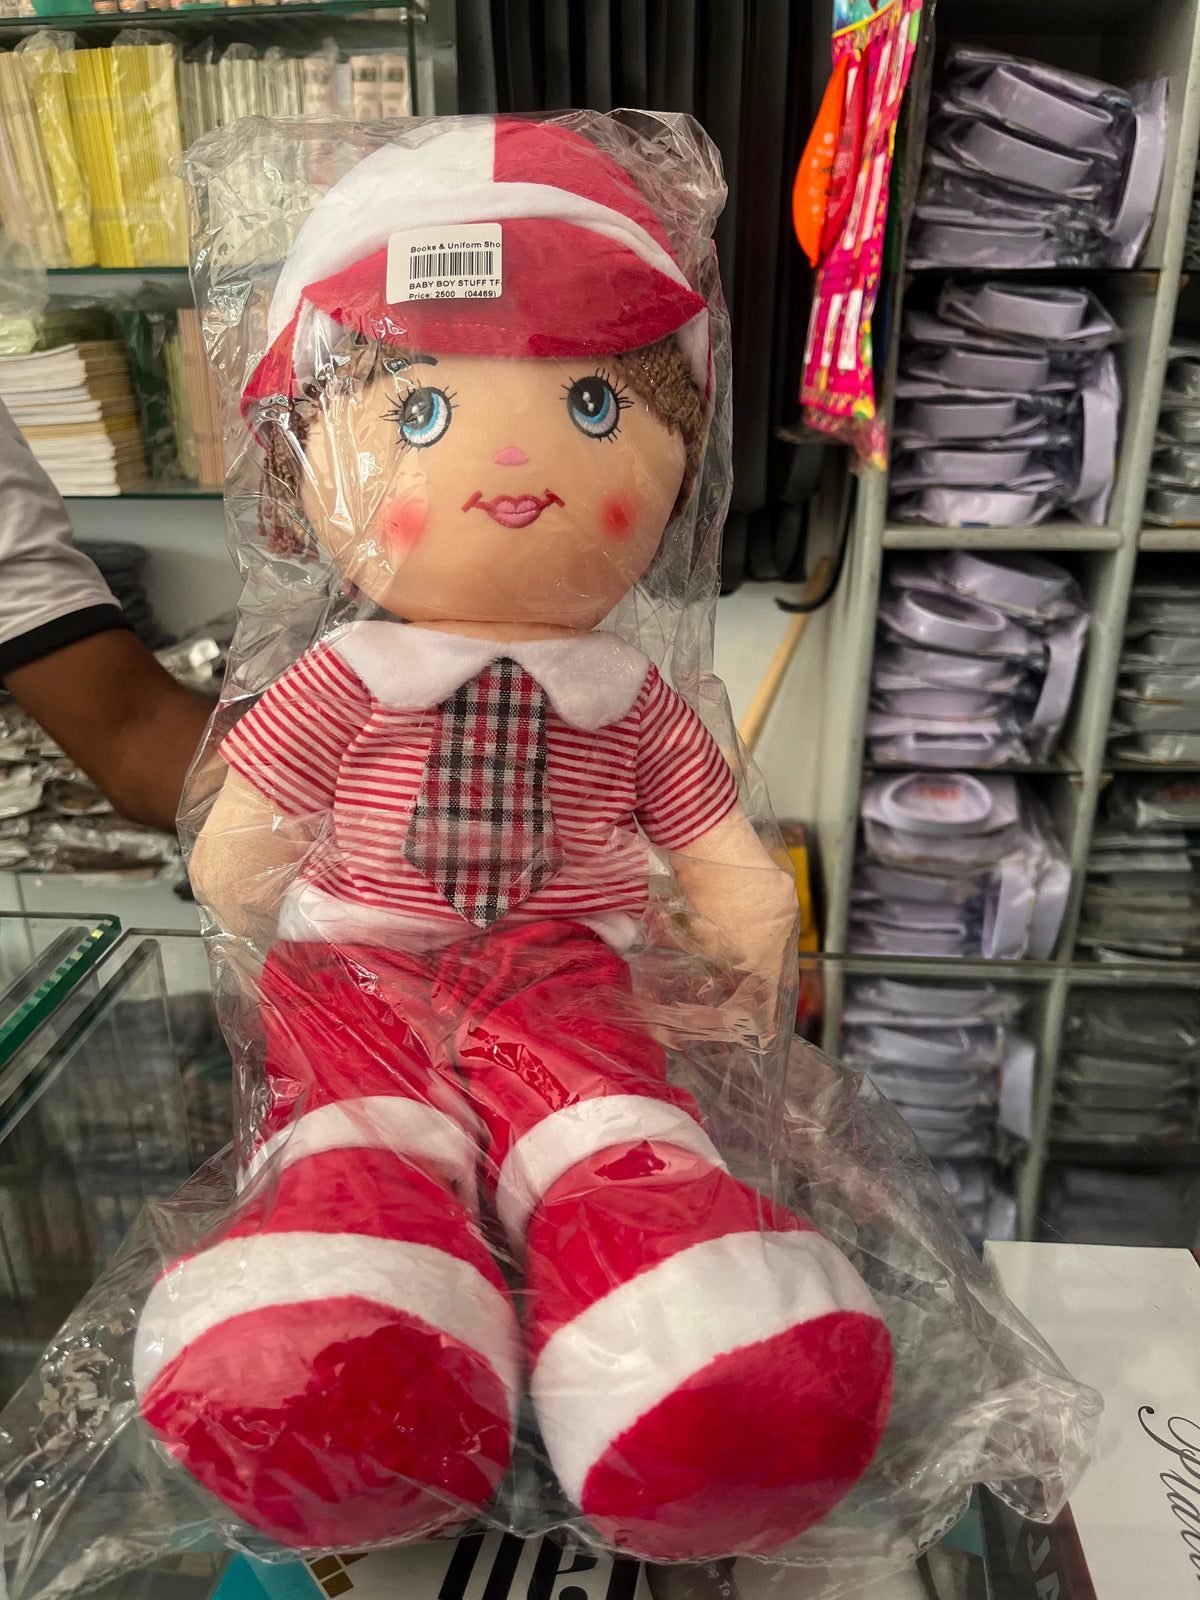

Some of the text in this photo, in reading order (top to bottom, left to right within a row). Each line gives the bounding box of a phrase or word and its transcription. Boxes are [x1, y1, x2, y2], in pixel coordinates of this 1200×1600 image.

[447, 241, 482, 249] Uniform
[409, 281, 434, 290] BABY
[458, 279, 487, 287] STUFF
